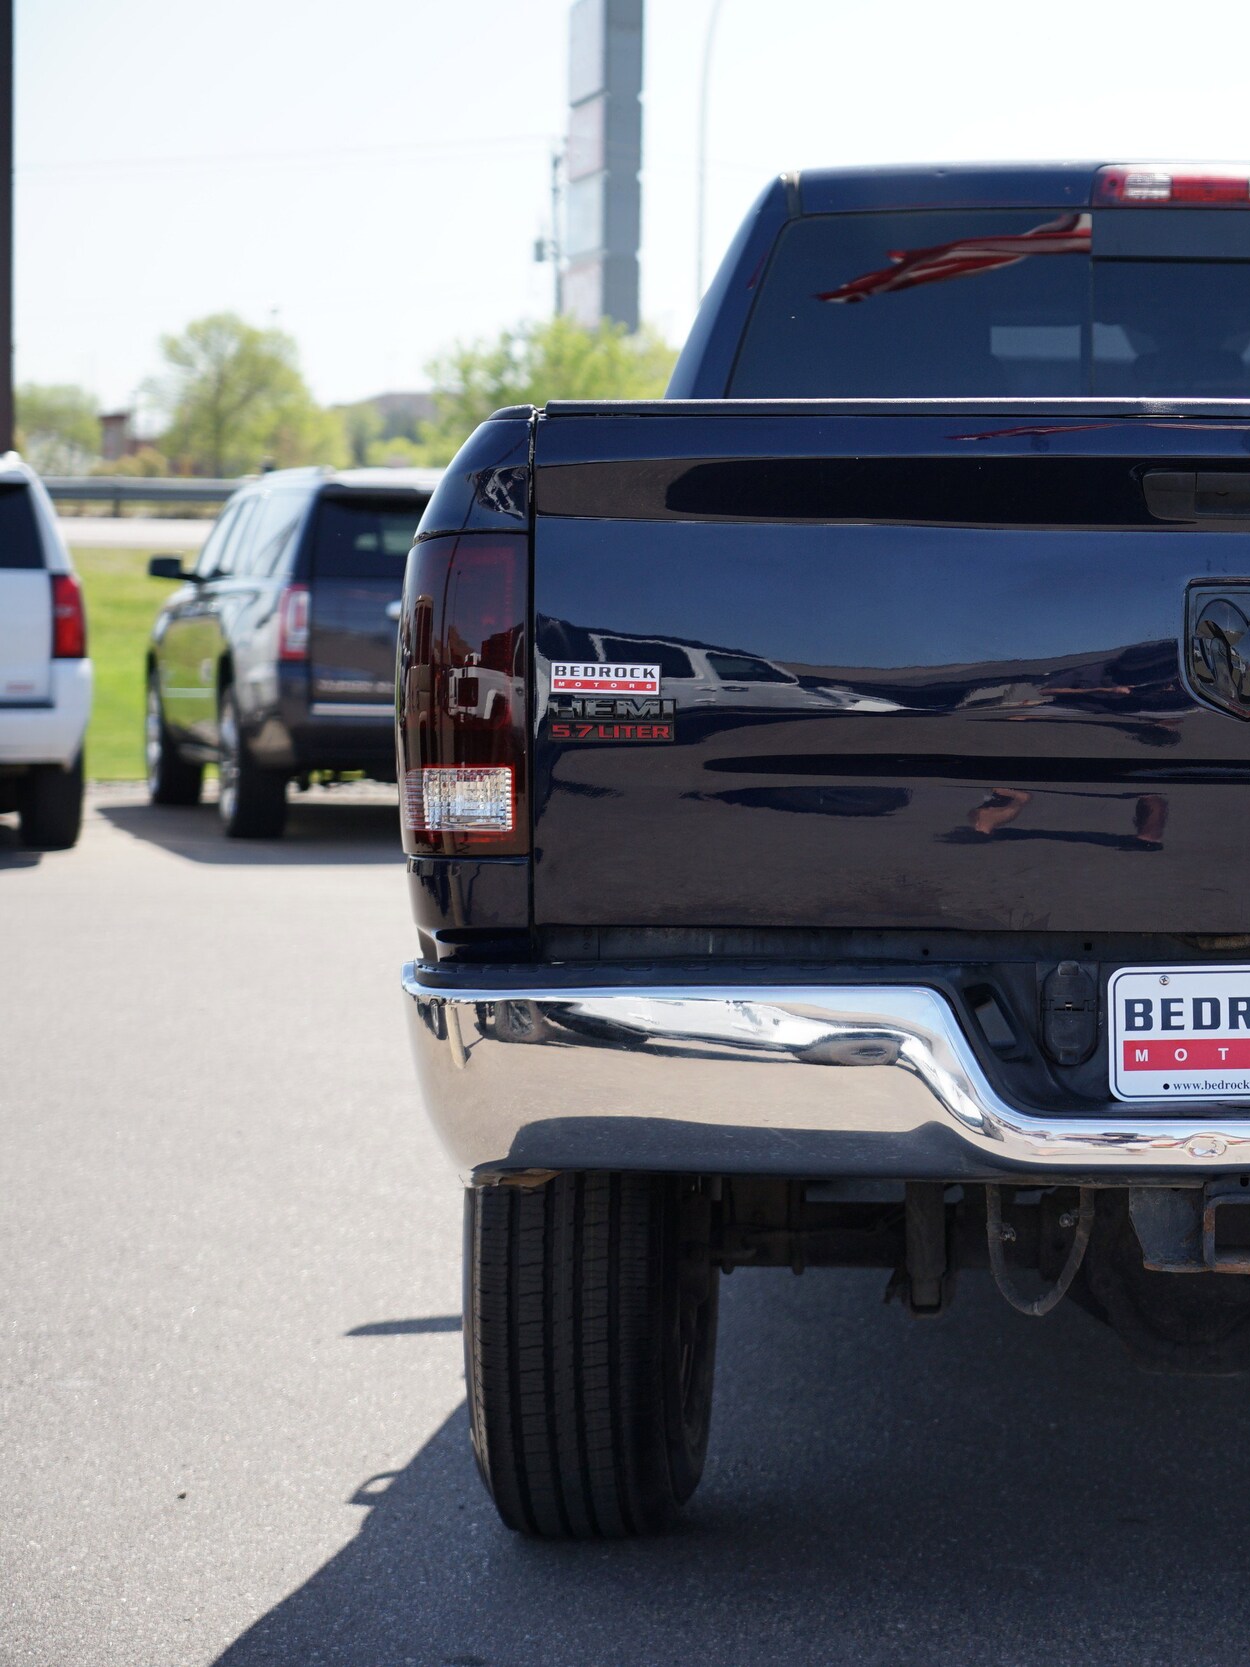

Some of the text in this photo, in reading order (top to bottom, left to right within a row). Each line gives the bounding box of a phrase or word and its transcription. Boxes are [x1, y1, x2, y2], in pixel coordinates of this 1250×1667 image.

[555, 665, 656, 678] BEDROCK
[558, 681, 652, 689] MOTORS
[548, 697, 677, 720] HEMI
[598, 725, 670, 739] LITER
